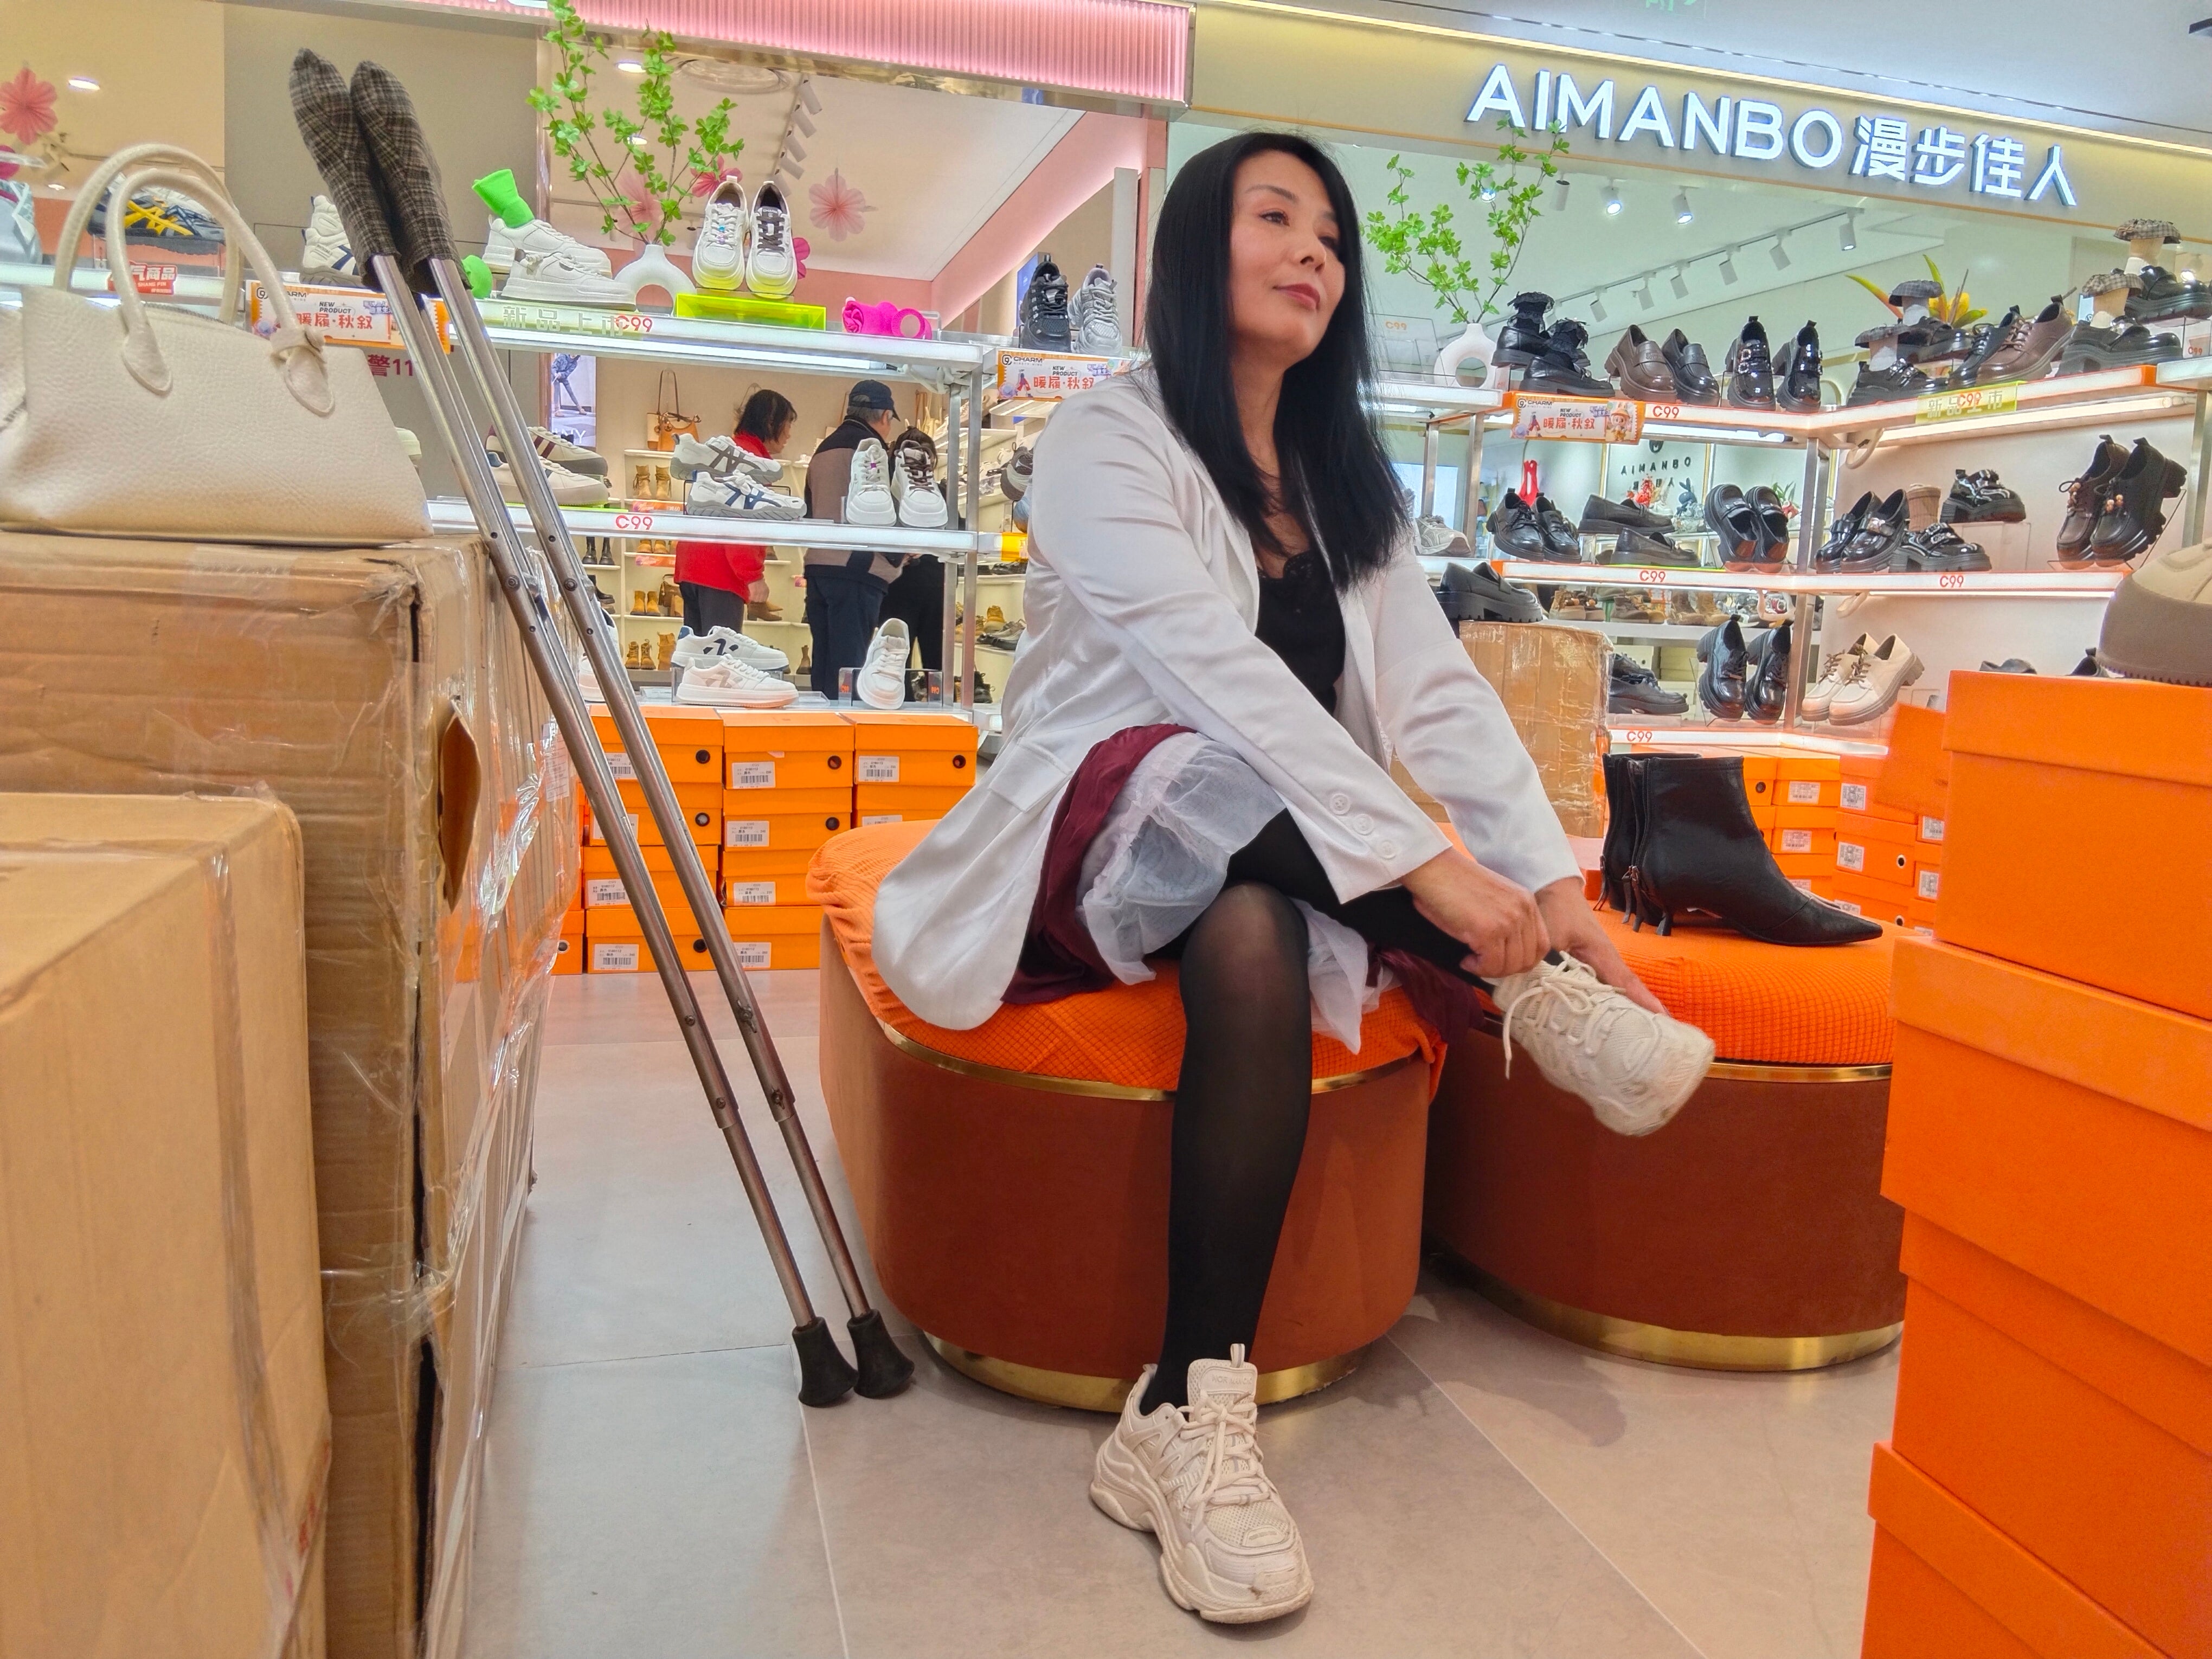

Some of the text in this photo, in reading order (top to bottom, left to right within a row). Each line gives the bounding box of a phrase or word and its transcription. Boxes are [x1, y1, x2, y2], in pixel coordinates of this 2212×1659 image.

[1464, 65, 1843, 169] AIMANBO
[1848, 114, 2078, 207] 漫步佳人
[615, 315, 653, 332] C99
[1385, 321, 1407, 330] C99
[2188, 346, 2203, 356] C99
[1956, 391, 1983, 407] C99
[1652, 406, 1680, 419] C99
[1621, 456, 1692, 475] AIMANBO
[615, 515, 653, 530] C99
[1639, 570, 1666, 583] C99
[1939, 575, 1964, 588] C99
[1626, 730, 1652, 743] C99
